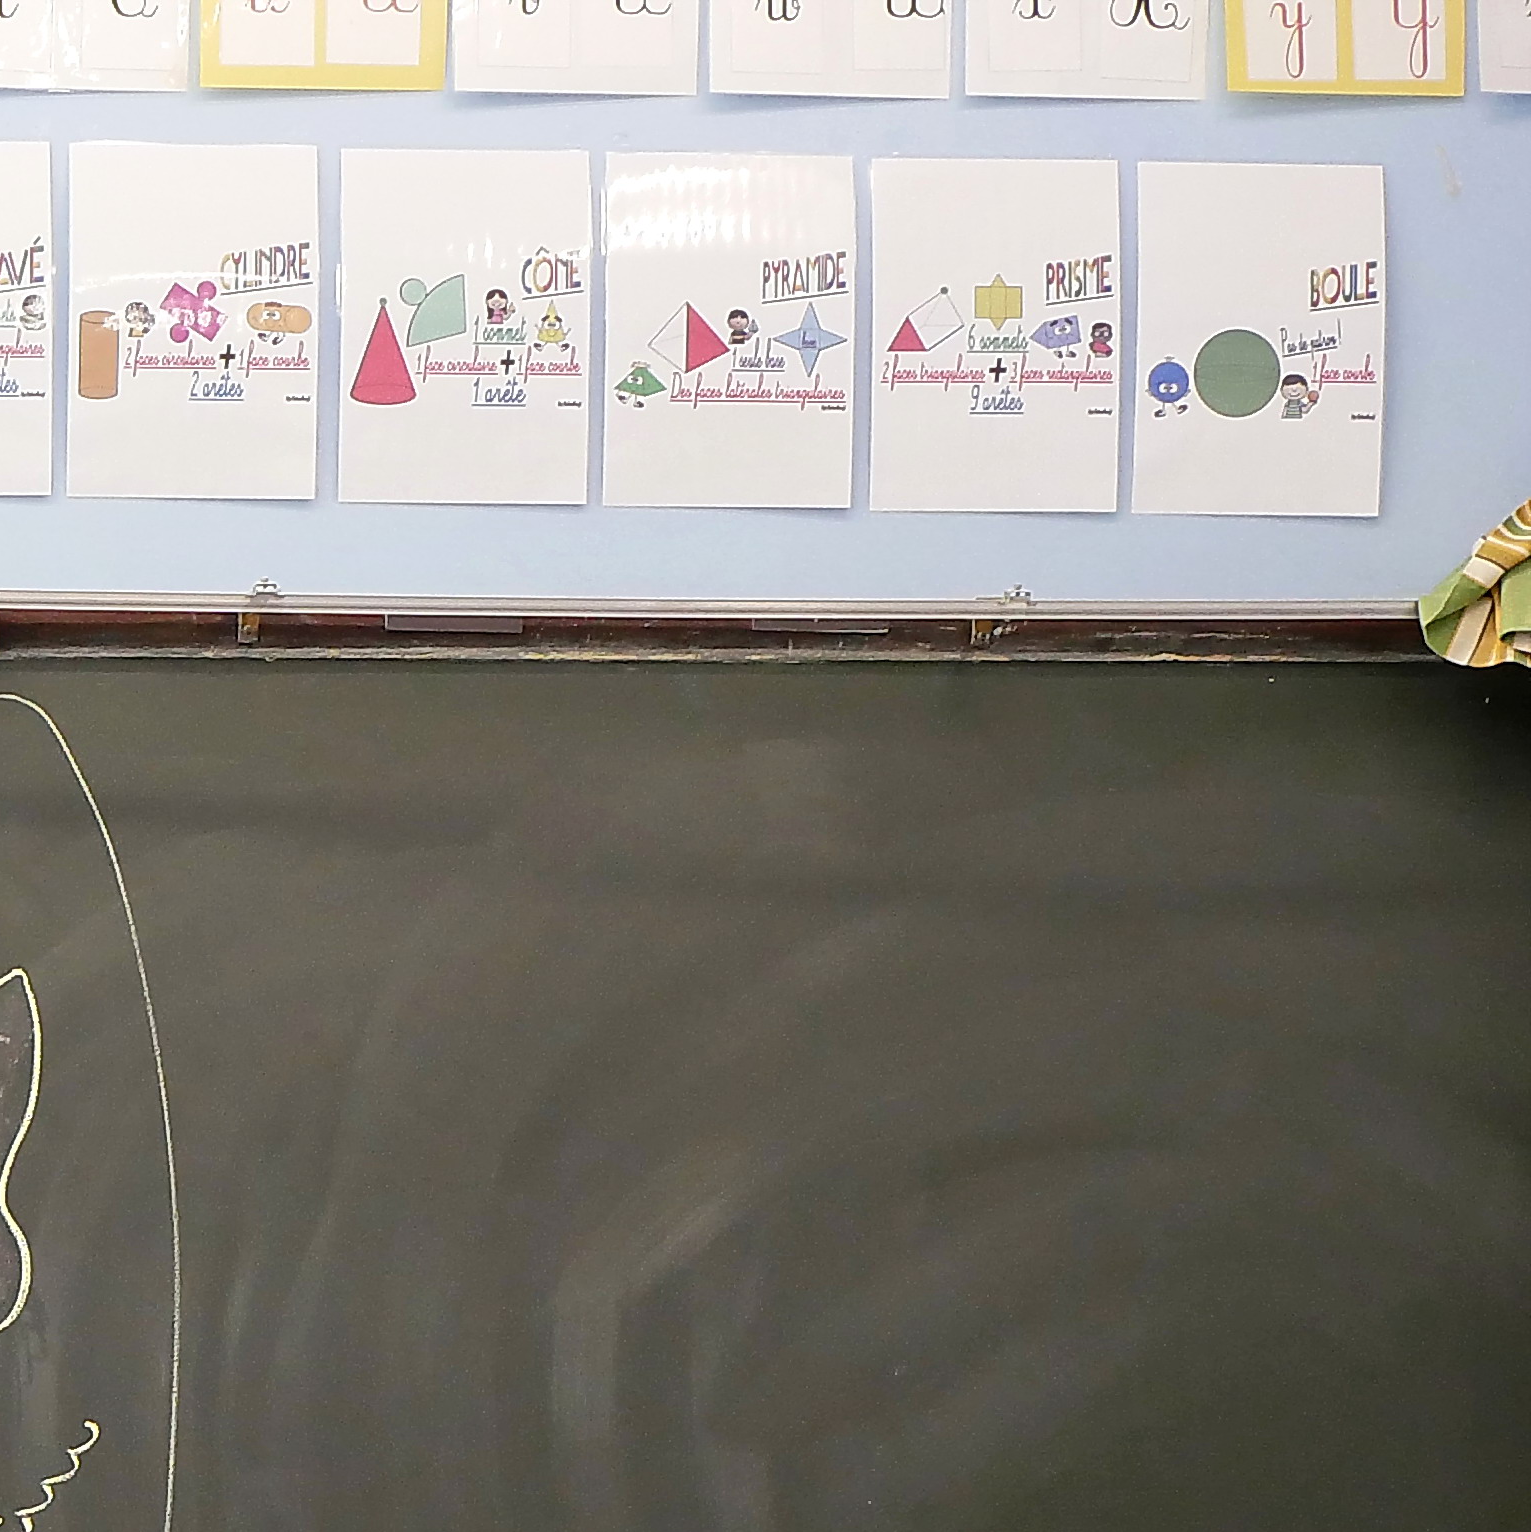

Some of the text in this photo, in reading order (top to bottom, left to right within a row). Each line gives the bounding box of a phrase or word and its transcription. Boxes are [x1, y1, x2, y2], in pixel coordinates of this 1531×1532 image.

[1269, 2, 1312, 79] y
[220, 242, 310, 290] CYLINDRE
[762, 251, 846, 299] PYRAMIDE
[1046, 255, 1112, 300] PRISME
[1310, 261, 1377, 307] BOULE
[190, 370, 200, 397] 2
